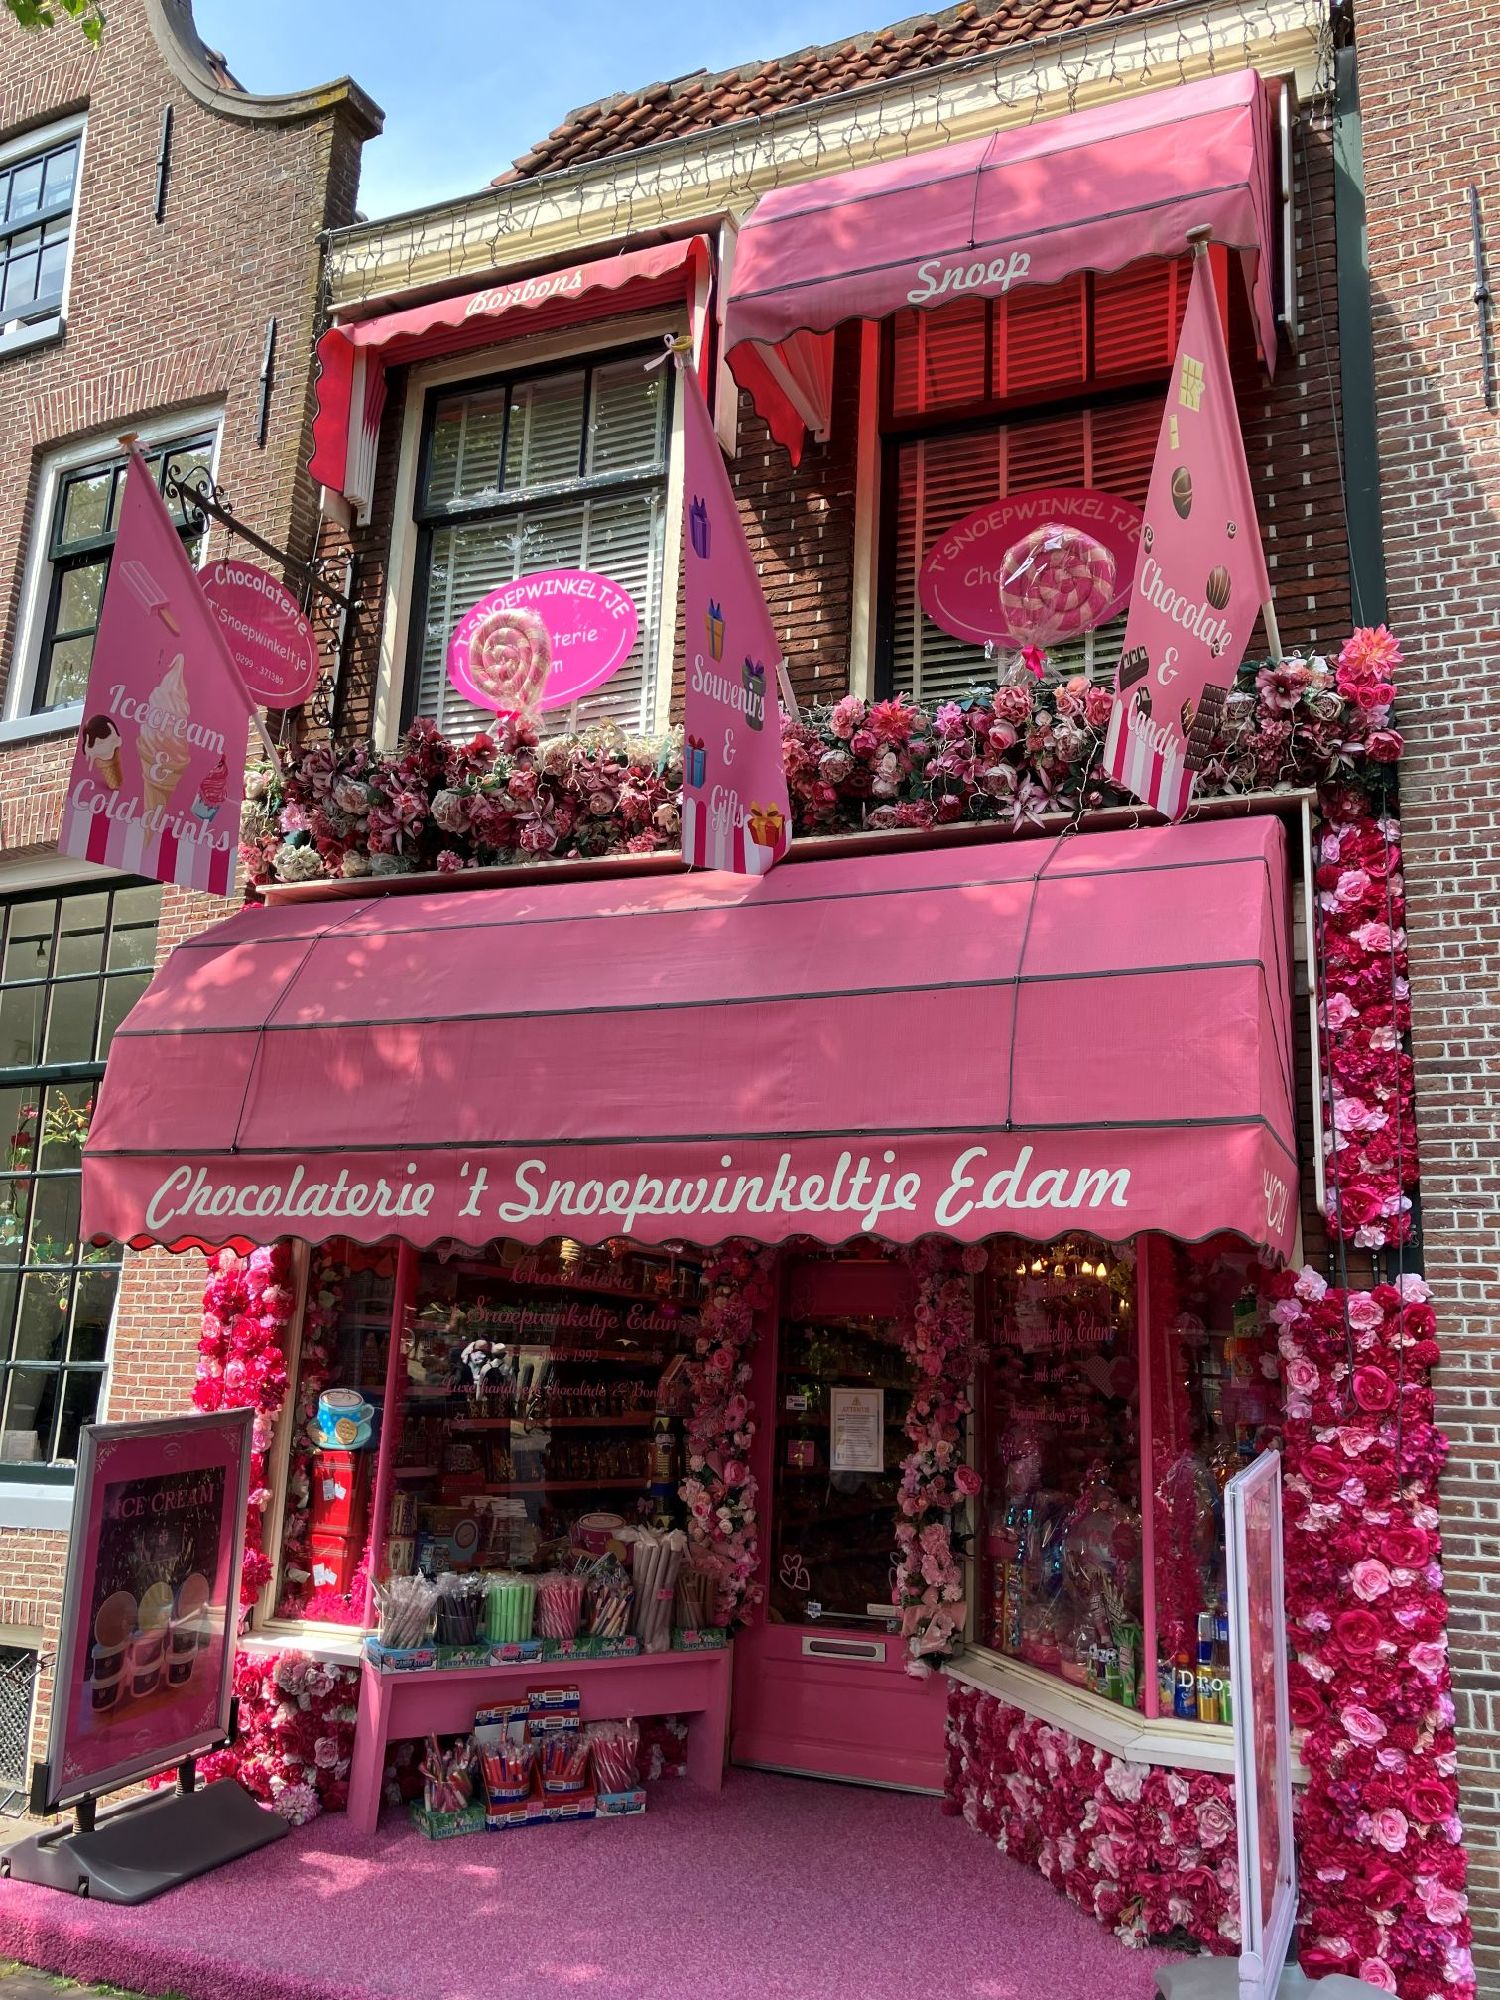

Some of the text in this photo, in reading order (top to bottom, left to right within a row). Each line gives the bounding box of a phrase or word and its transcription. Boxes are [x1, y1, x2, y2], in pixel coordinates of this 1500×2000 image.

[466, 269, 583, 316] Bonbons
[907, 250, 1032, 304] Snoep
[215, 564, 308, 636] Chocolaterie
[1140, 558, 1232, 657] Chocolate
[235, 652, 254, 668] 0299
[692, 653, 765, 722] Souvenirs
[1157, 646, 1180, 686] &
[109, 684, 226, 755] Icecream
[722, 728, 737, 766] &
[1127, 691, 1180, 773] Candy
[150, 751, 173, 782] &
[72, 779, 230, 851] Cold drinks
[710, 784, 744, 836] Gifts
[145, 1145, 1133, 1233] Chocolaterie 't Snoepwinkeltje Edam
